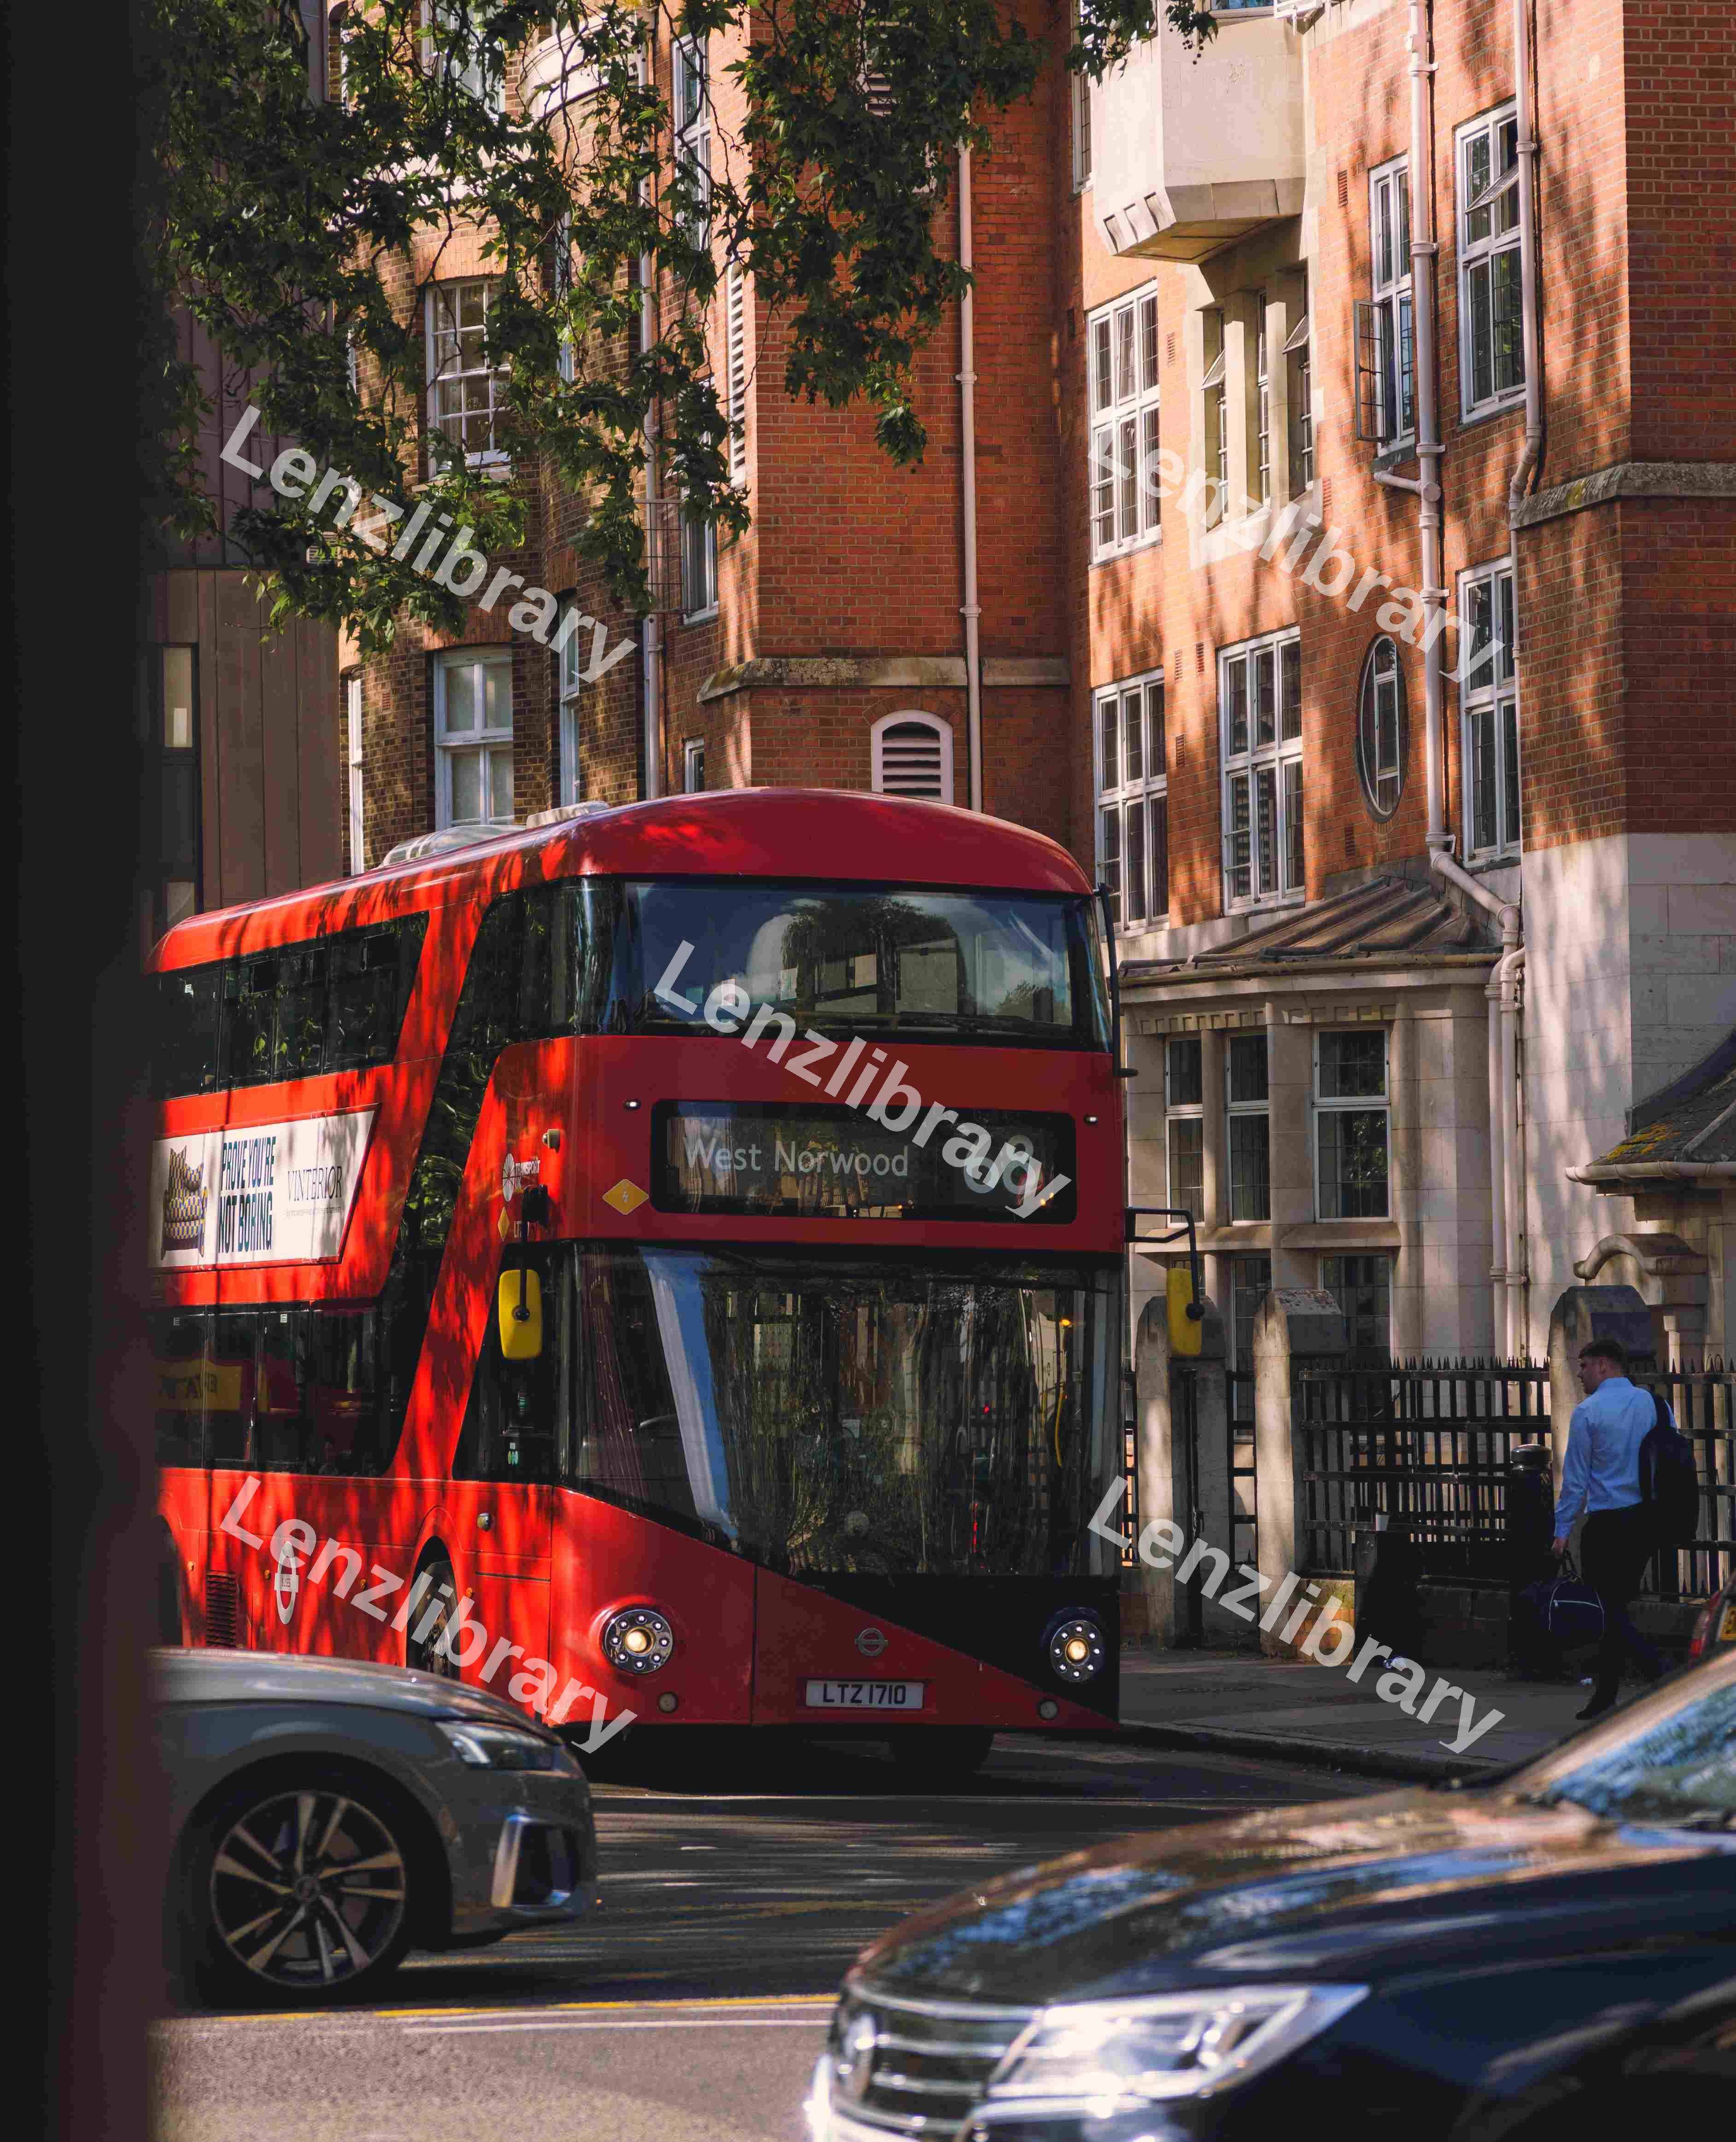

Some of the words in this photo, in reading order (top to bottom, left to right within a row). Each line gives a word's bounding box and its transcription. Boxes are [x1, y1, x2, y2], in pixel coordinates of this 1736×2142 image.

[221, 1140, 247, 1190] PROVE
[248, 1136, 276, 1188] YOU'RE
[683, 1136, 761, 1171] West
[775, 1141, 909, 1176] Norwood
[964, 1135, 1044, 1194] 68
[287, 1166, 342, 1201] VINTERIOR
[218, 1194, 237, 1253] NOT
[238, 1191, 273, 1252] BORING
